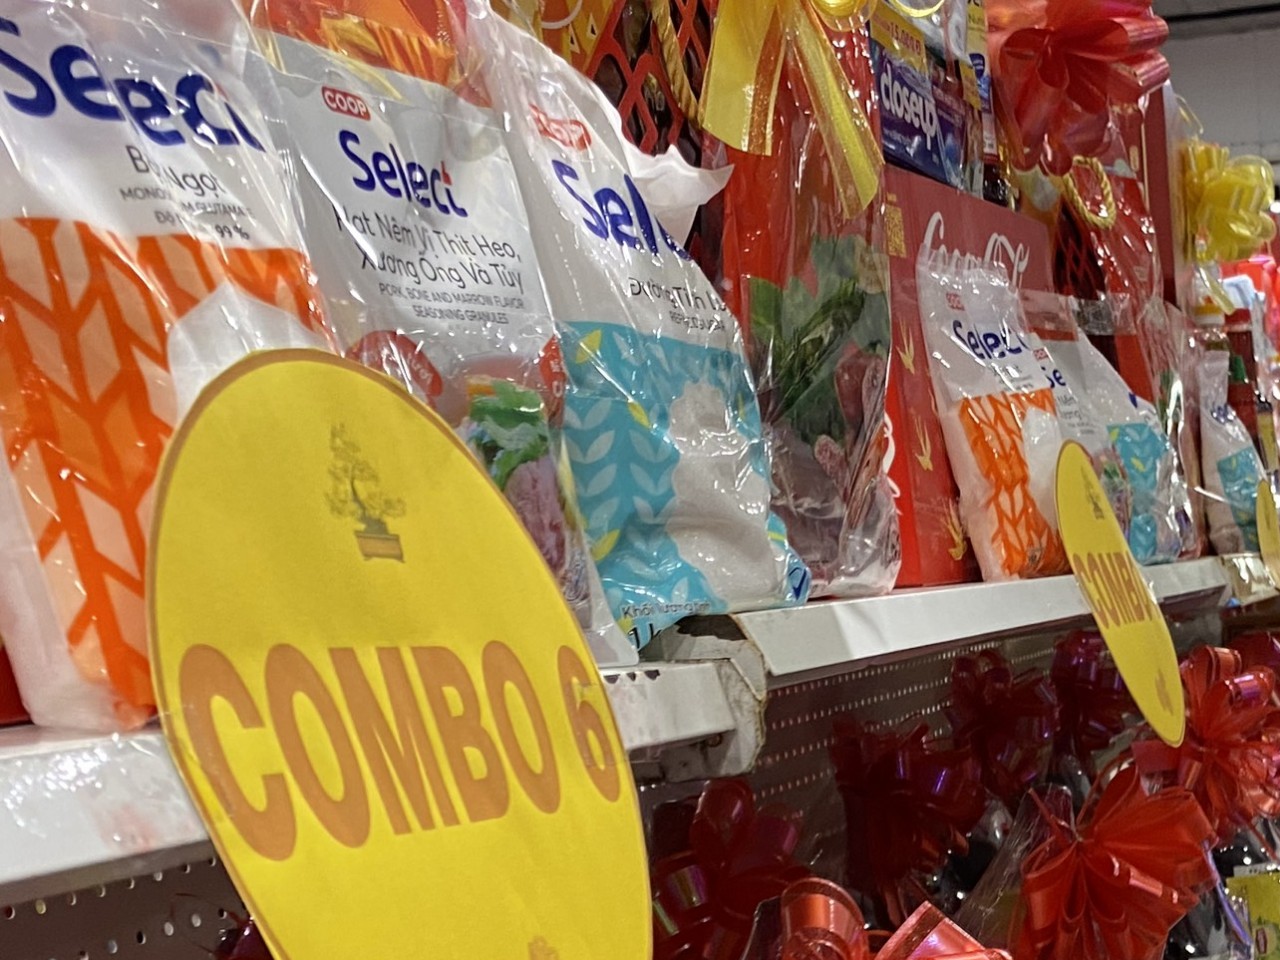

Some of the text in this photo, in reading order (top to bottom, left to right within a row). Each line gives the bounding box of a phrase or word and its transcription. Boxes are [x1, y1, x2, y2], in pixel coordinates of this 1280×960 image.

[324, 89, 368, 116] COOP
[880, 62, 938, 150] closeup
[338, 130, 468, 217] Select
[374, 212, 416, 248] Nêm
[431, 228, 476, 257] Thịt
[477, 233, 523, 262] Heo,
[459, 258, 494, 286] Và
[490, 261, 525, 296] Tủy
[179, 640, 622, 861] COMBO 6
